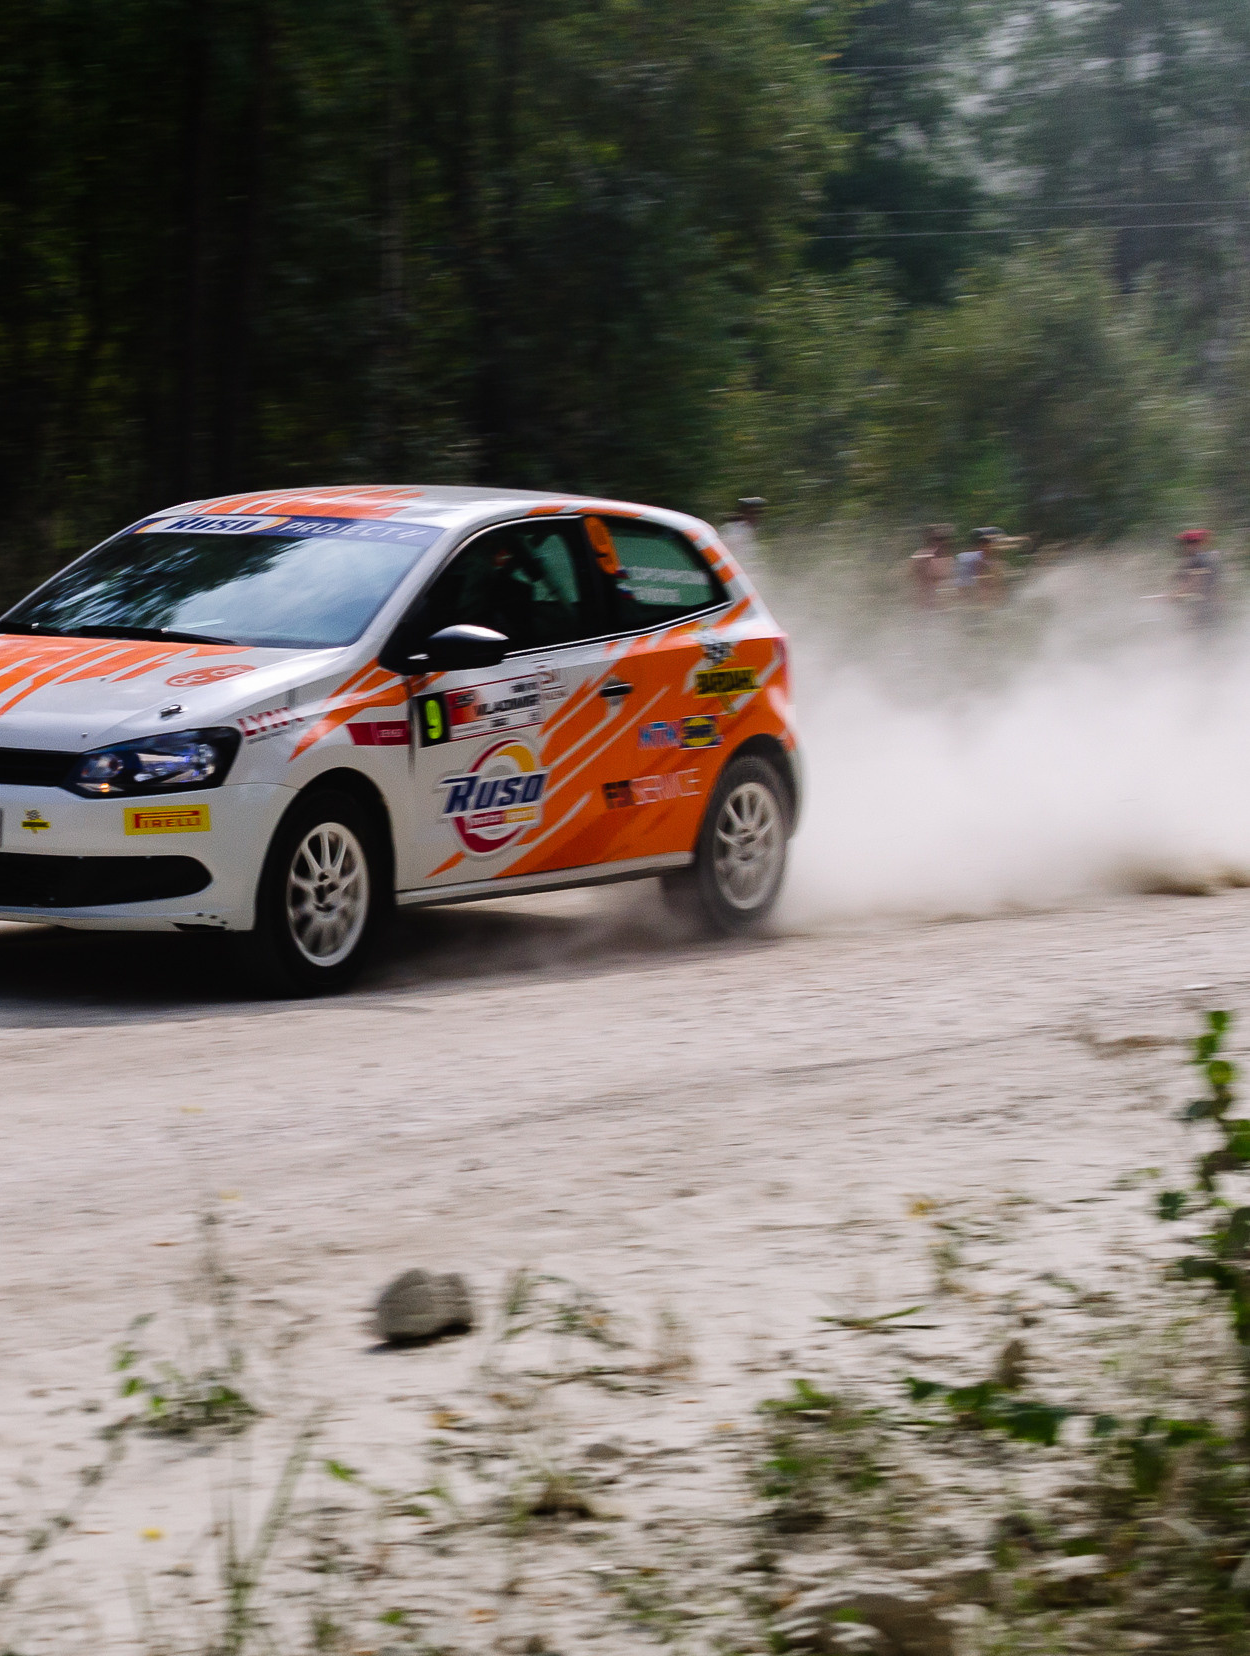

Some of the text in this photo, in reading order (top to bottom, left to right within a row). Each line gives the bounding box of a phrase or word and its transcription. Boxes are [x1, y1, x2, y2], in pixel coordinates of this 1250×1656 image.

[278, 521, 401, 537] PROJECT
[423, 698, 444, 740] 9
[132, 809, 202, 829] PIRELLI
